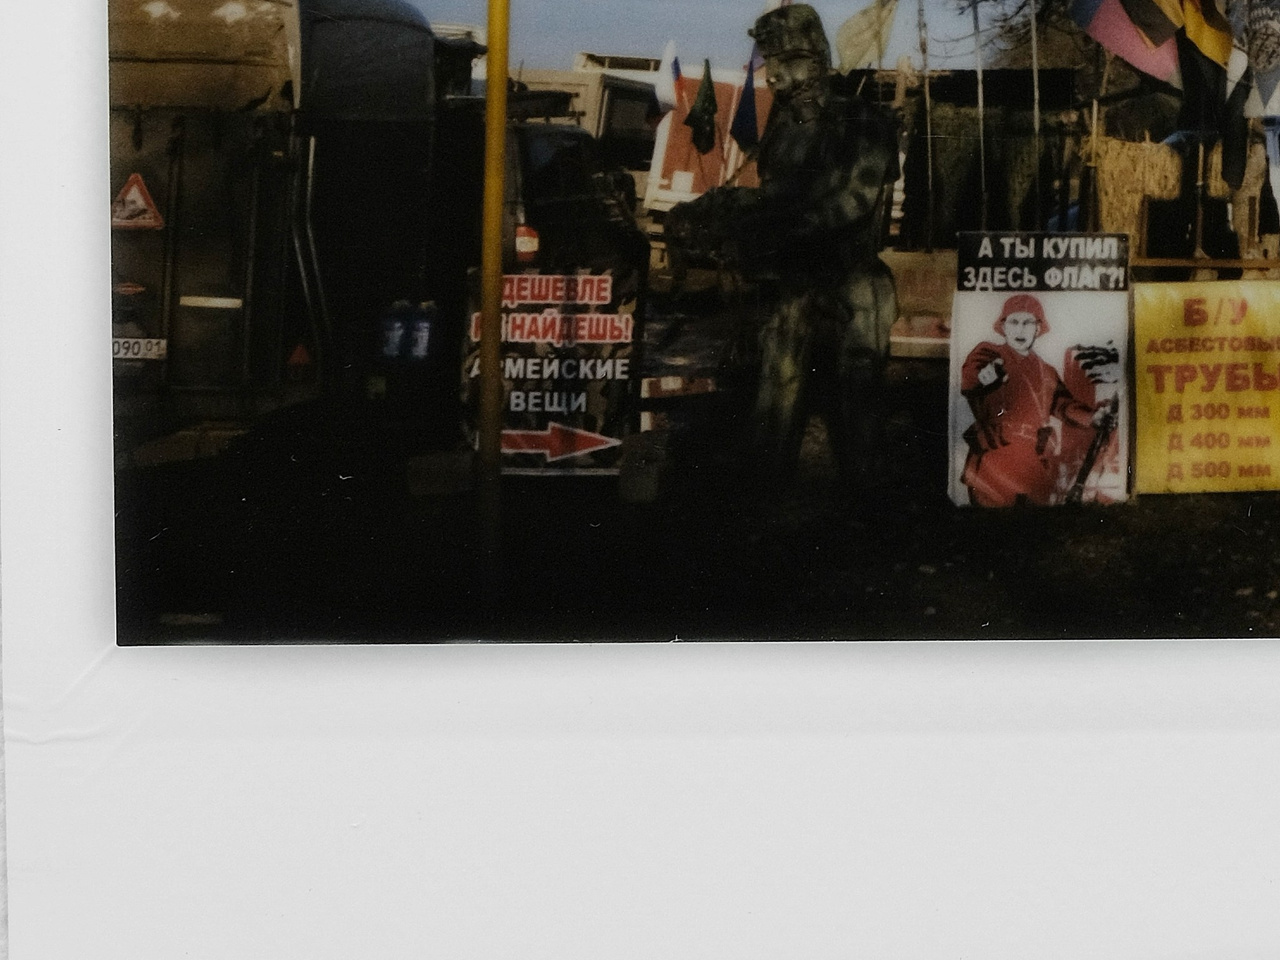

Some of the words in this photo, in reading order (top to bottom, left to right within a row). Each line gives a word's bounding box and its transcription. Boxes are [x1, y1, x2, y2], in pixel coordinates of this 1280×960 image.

[977, 237, 993, 259] А
[1000, 237, 1035, 259] ТЫ
[1042, 237, 1118, 259] КУПИЛ
[963, 266, 1037, 291] ЗДЕСЬ
[1044, 266, 1125, 289] ФЛАГ?!
[501, 275, 612, 308] ДЕШЕВЛЕ
[1183, 297, 1248, 327] Б/У
[508, 308, 634, 347] НАЙДЕШЬ!
[509, 391, 587, 415] ВЕЩИ
[1166, 403, 1183, 424] Д
[1190, 402, 1230, 420] 300
[1190, 432, 1230, 449] 400
[1190, 460, 1231, 478] 500
